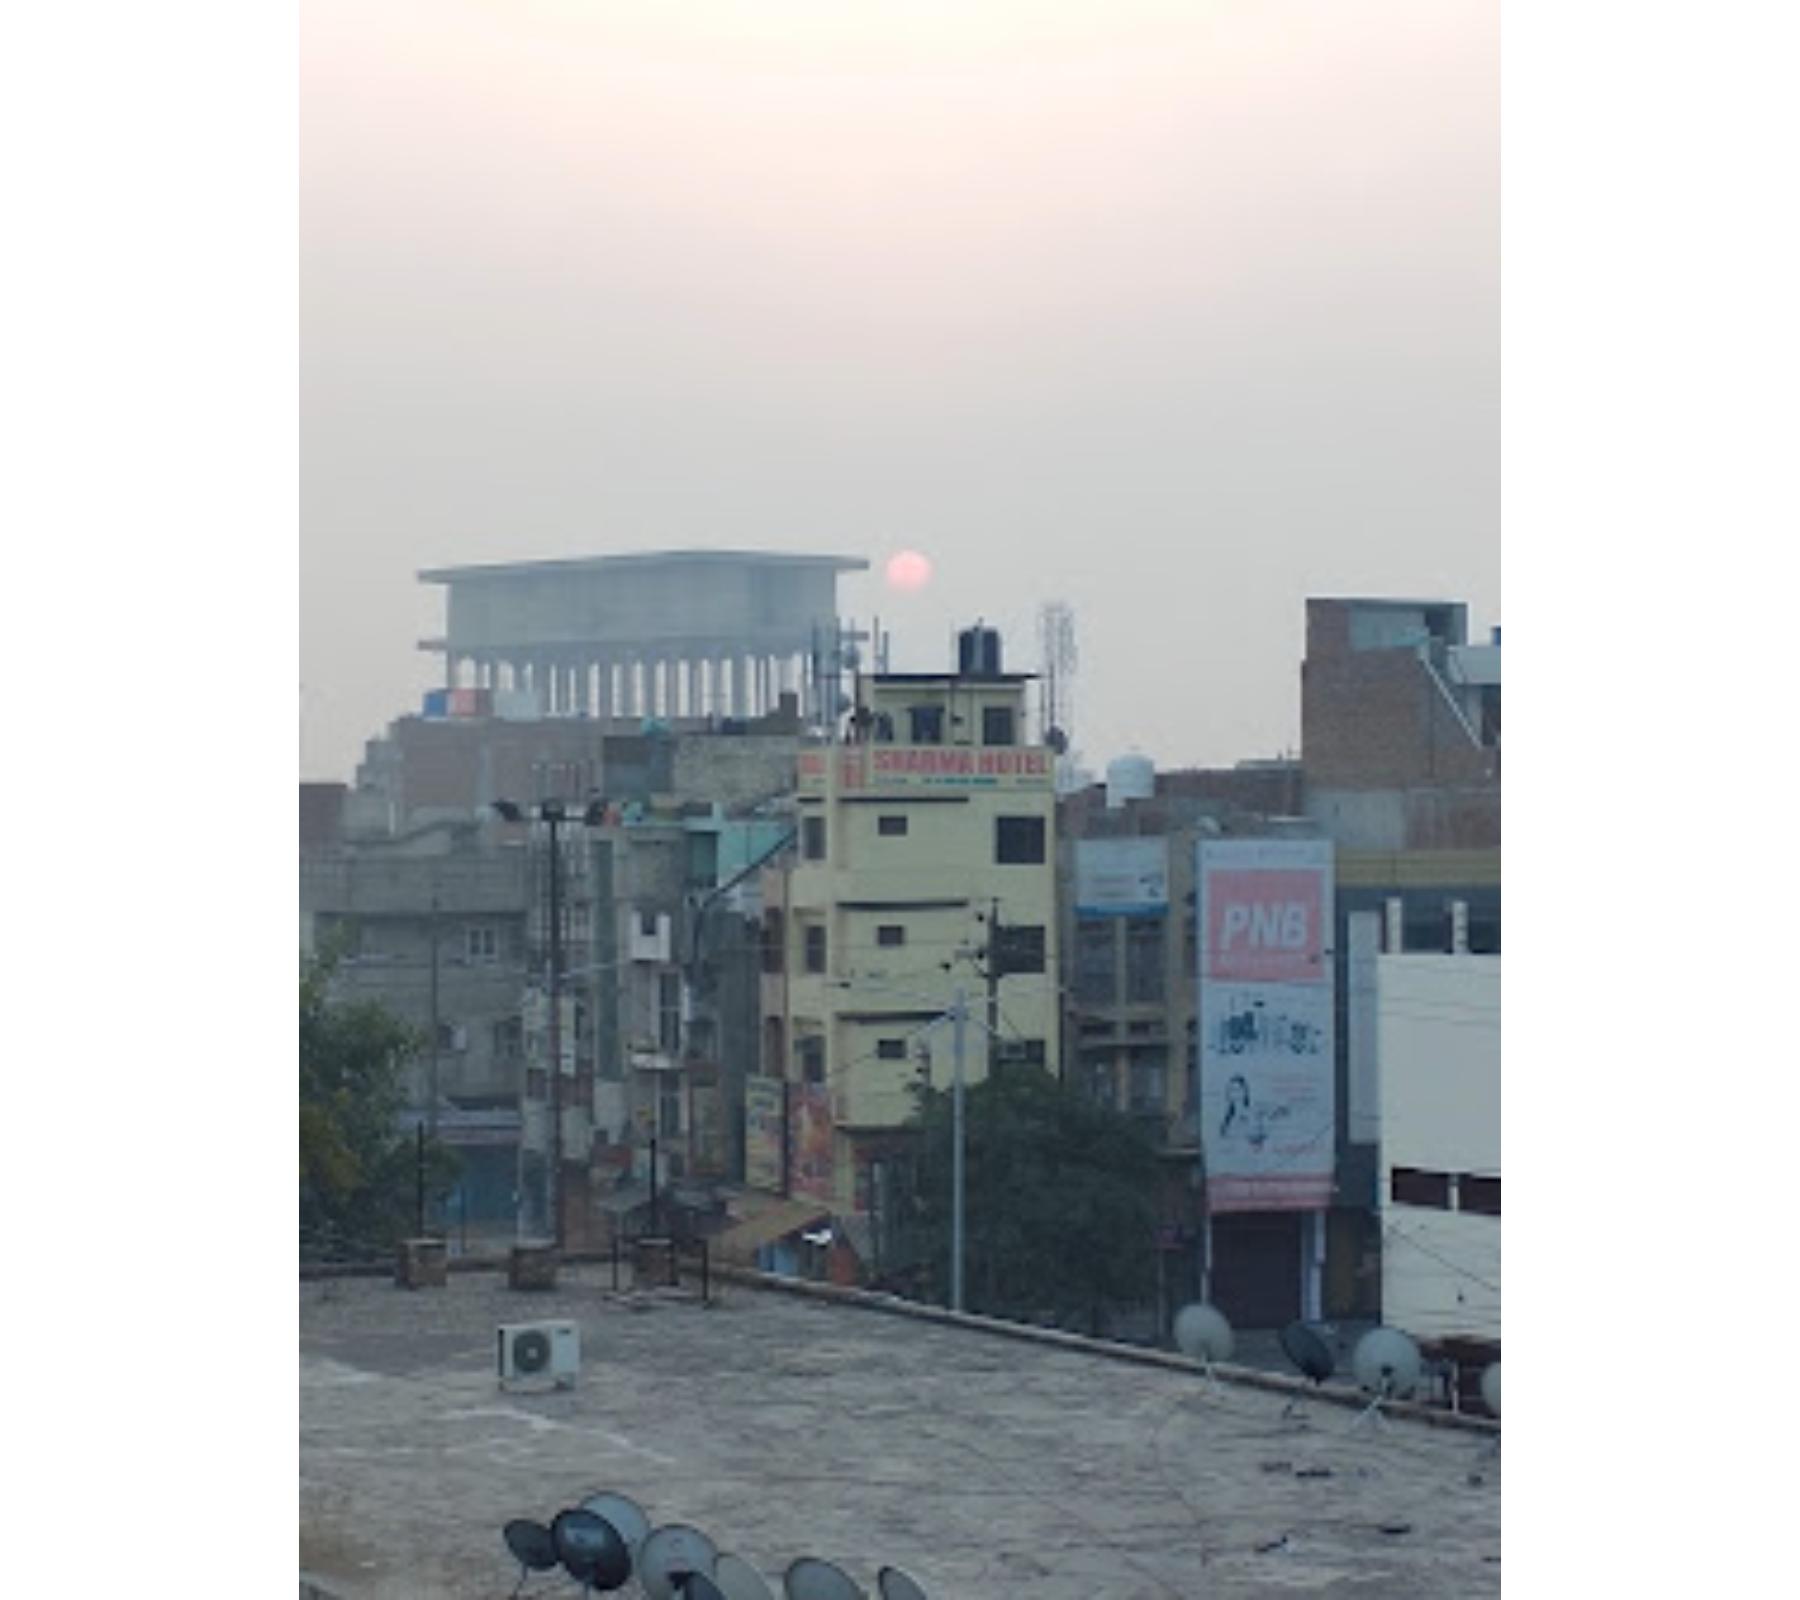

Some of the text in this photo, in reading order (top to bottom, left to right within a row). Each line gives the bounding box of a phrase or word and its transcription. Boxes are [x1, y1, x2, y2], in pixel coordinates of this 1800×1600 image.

[873, 750, 973, 774] SHARMA
[977, 751, 1048, 774] HOTEL
[1220, 902, 1307, 949] PNB
